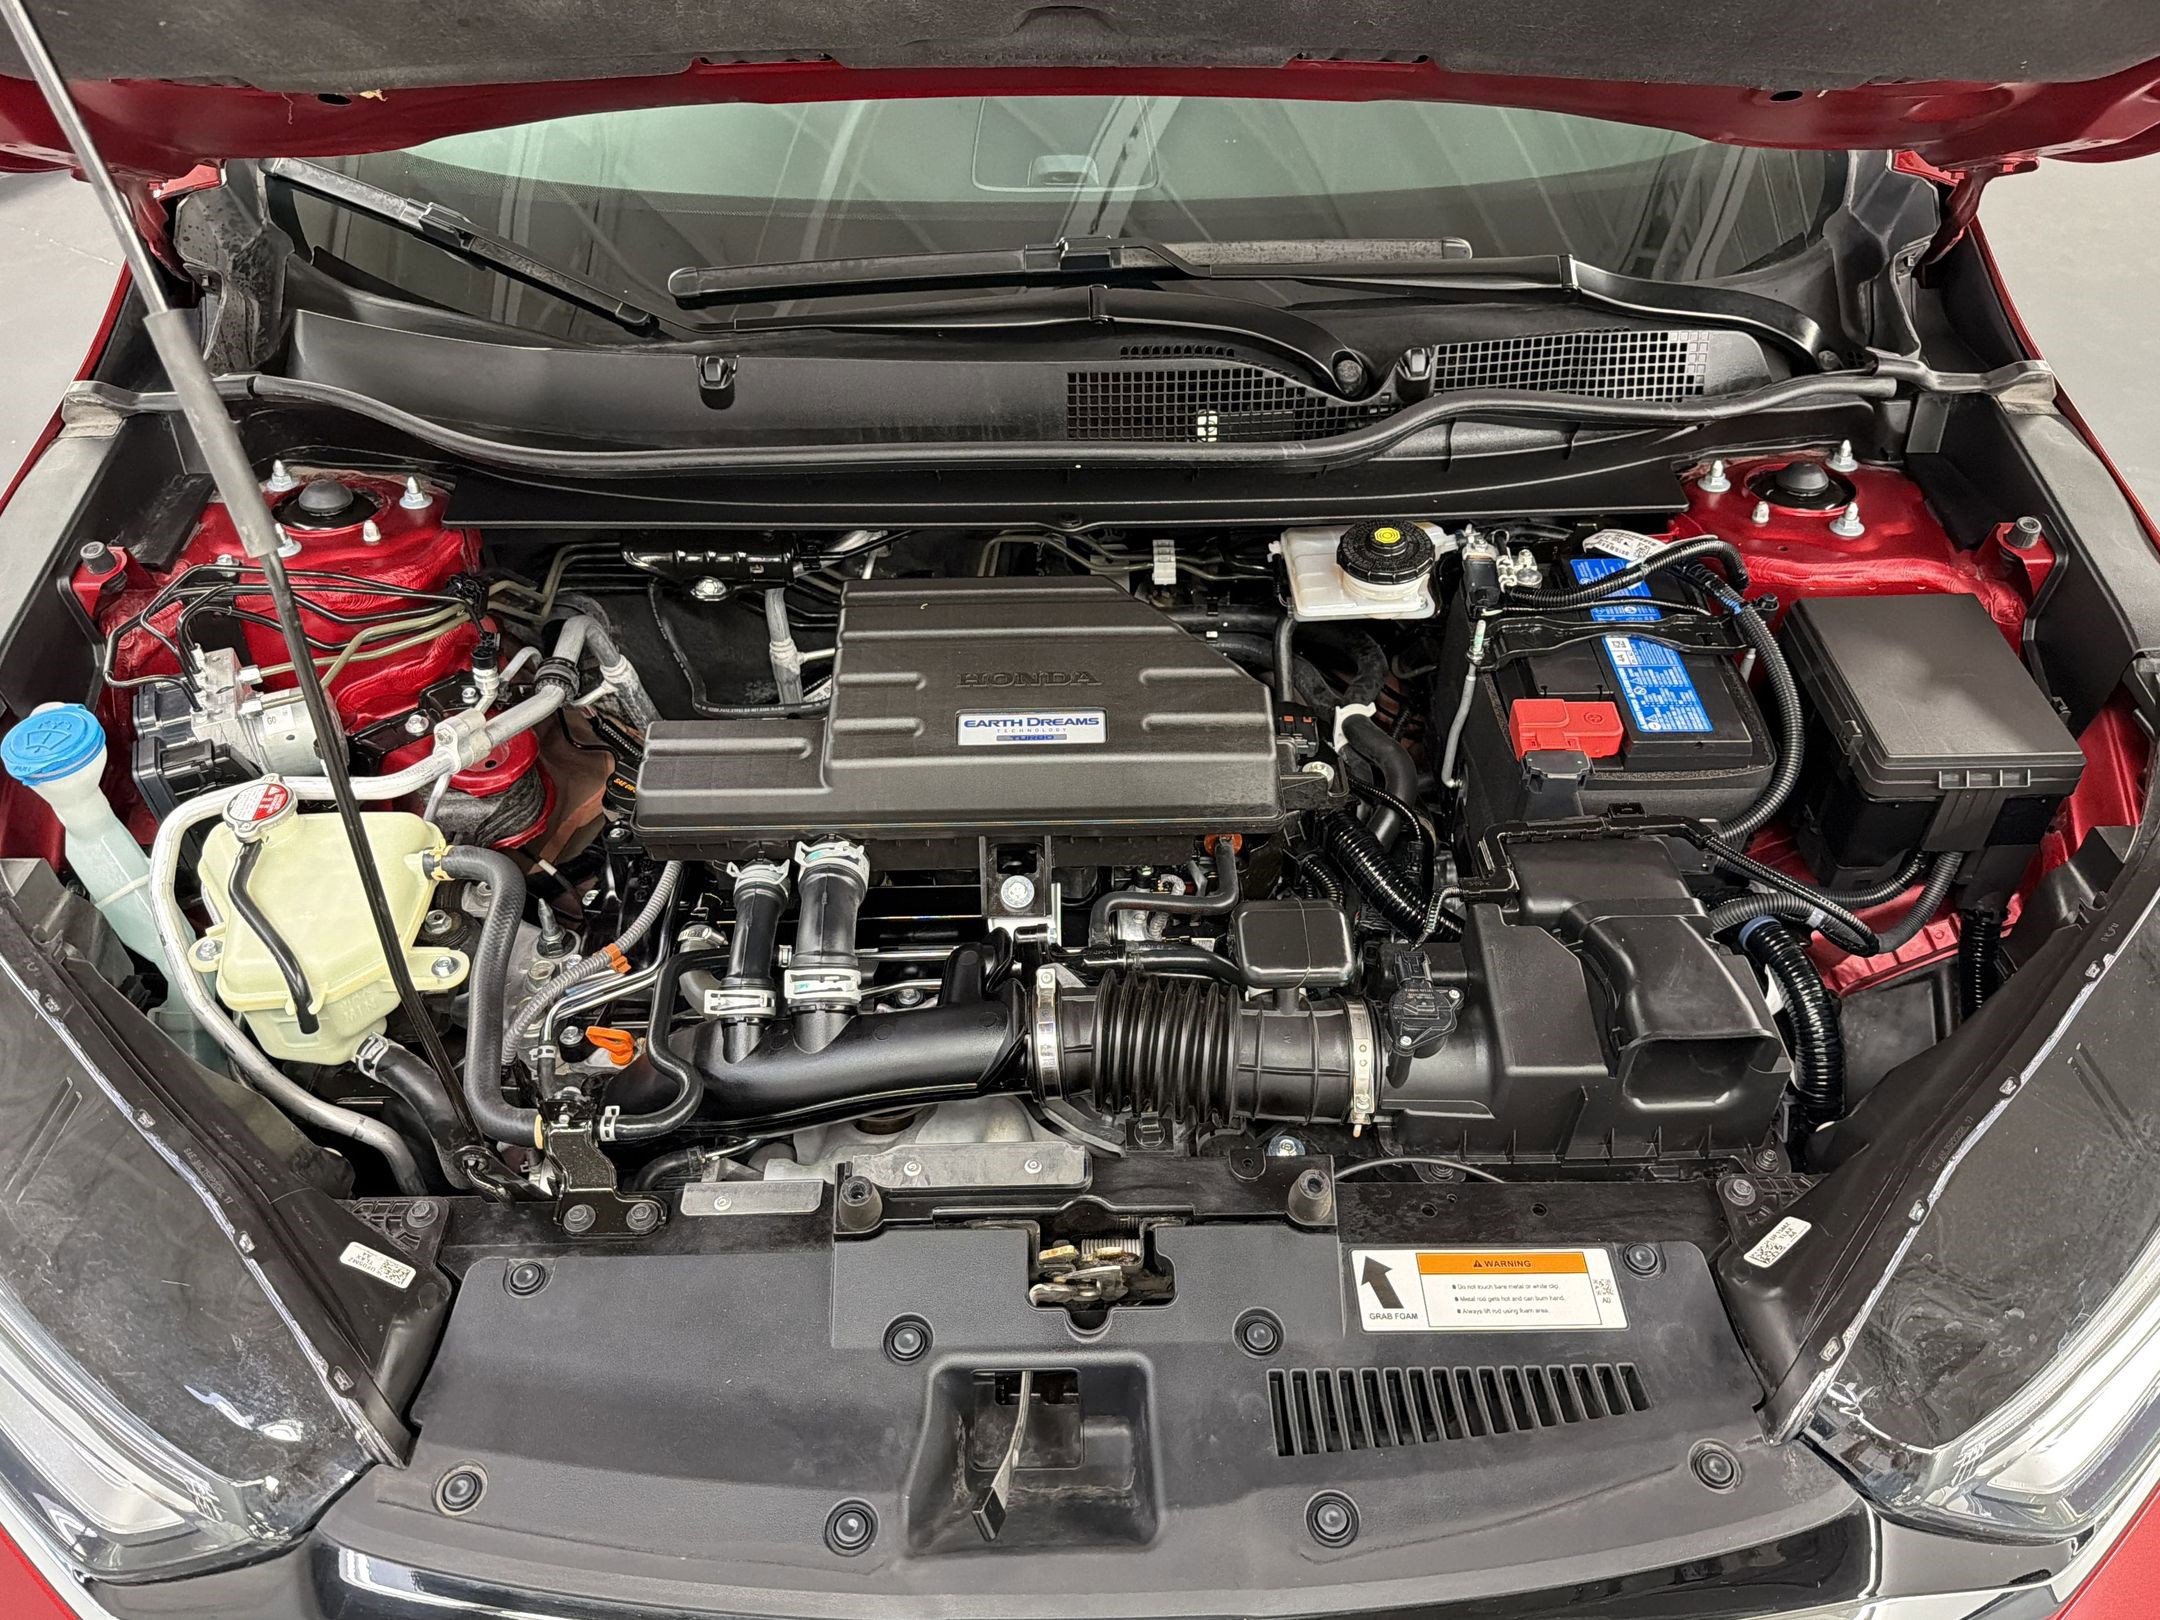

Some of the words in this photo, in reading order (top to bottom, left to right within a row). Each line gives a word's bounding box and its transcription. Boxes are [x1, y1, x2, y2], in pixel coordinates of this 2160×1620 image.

[956, 671, 1102, 688] HONDA
[964, 719, 1023, 728] EARTH
[1027, 717, 1099, 727] DREAMS
[1485, 1260, 1532, 1268] WARNING
[1369, 1312, 1394, 1320] GRAB
[1394, 1311, 1419, 1320] FOAM
